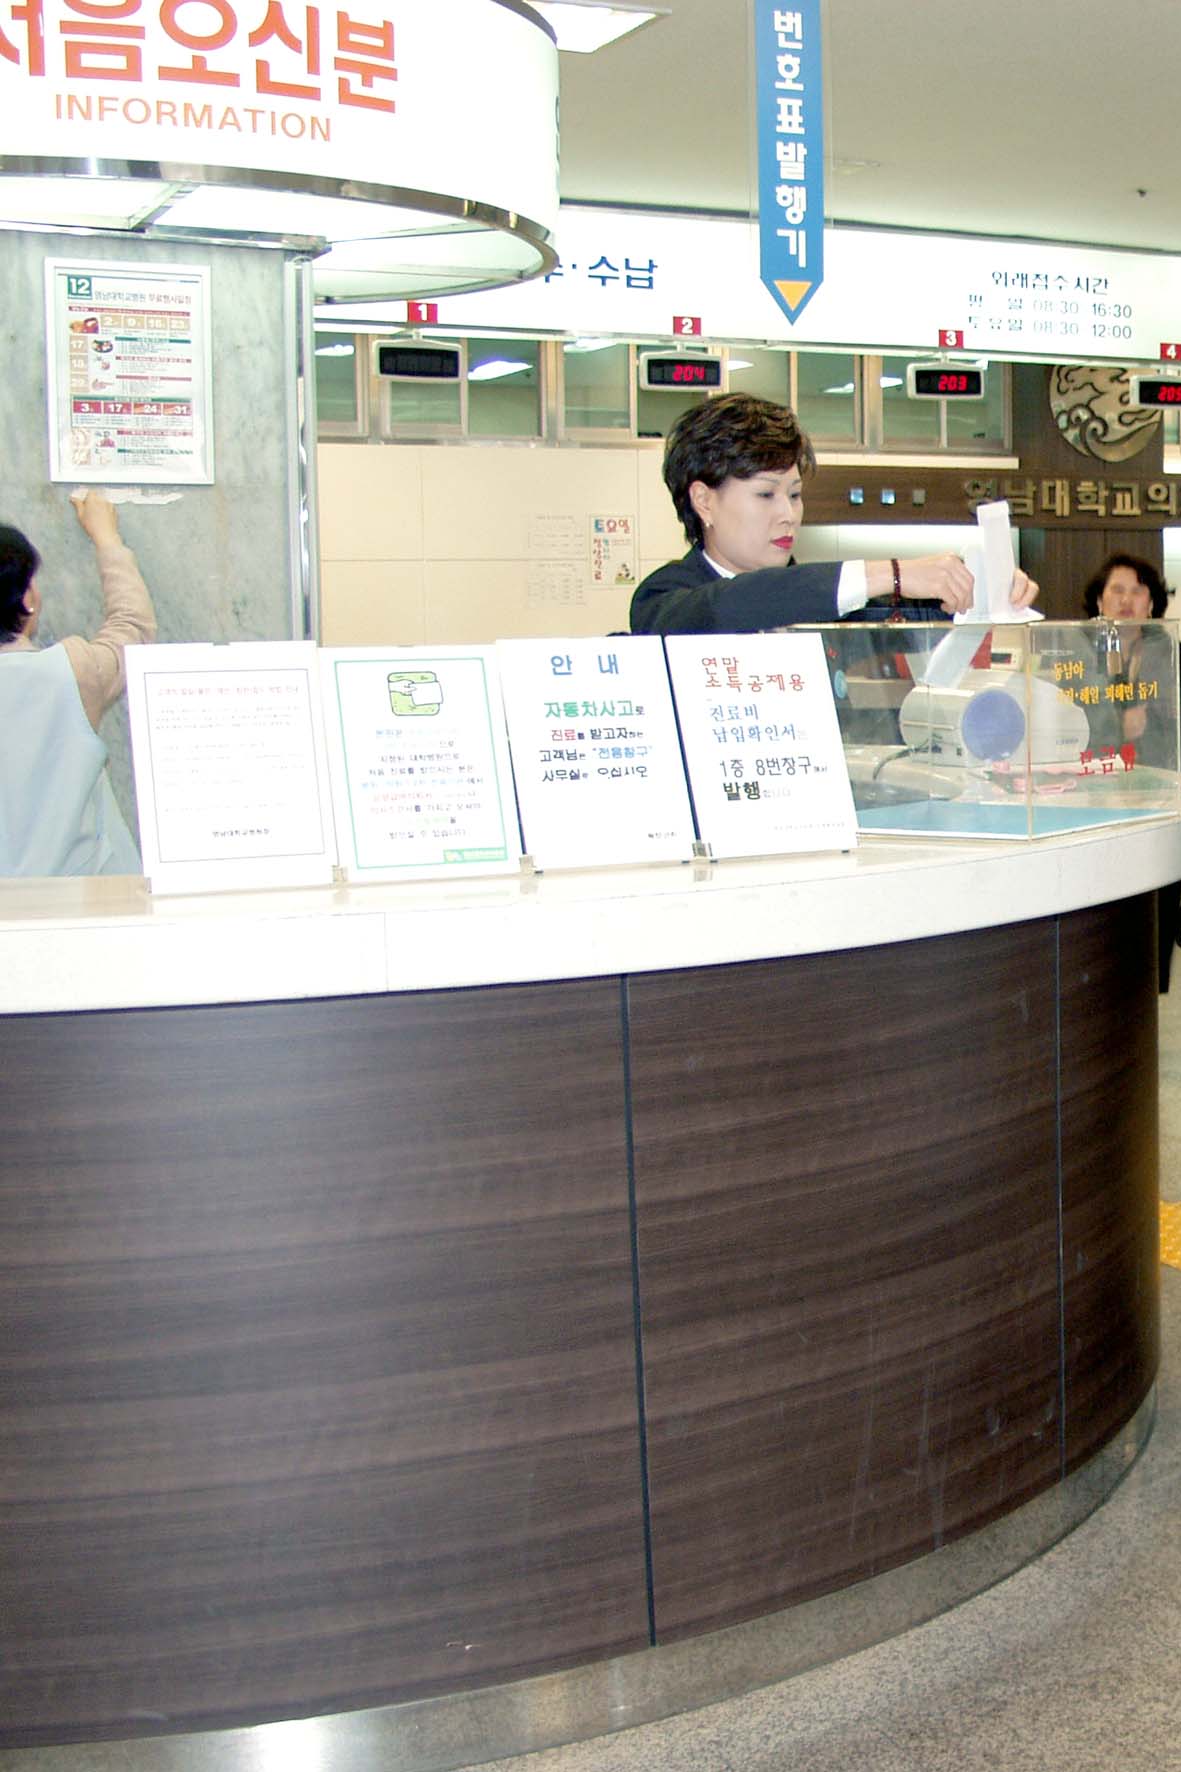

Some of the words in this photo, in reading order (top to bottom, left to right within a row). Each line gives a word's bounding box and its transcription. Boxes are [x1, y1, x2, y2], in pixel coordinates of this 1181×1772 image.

[55, 93, 332, 143] INFORMATION
[773, 10, 808, 269] 번호표발행기
[70, 278, 90, 295] 12
[991, 271, 1110, 296] 외래접수시간
[416, 303, 429, 321] 1
[1092, 303, 1133, 319] 16:30
[680, 317, 694, 335] 2
[1092, 323, 1133, 340] 12:00
[945, 330, 957, 347] 3
[1166, 344, 1177, 360] 4
[672, 364, 704, 382] 204
[938, 374, 967, 391] 203
[109, 403, 123, 412] 17
[143, 404, 157, 413] 24
[1054, 661, 1085, 682] 동남아
[705, 673, 806, 693] 소득공제용
[543, 700, 646, 719] 자동차사고로
[710, 703, 760, 722] 진료비
